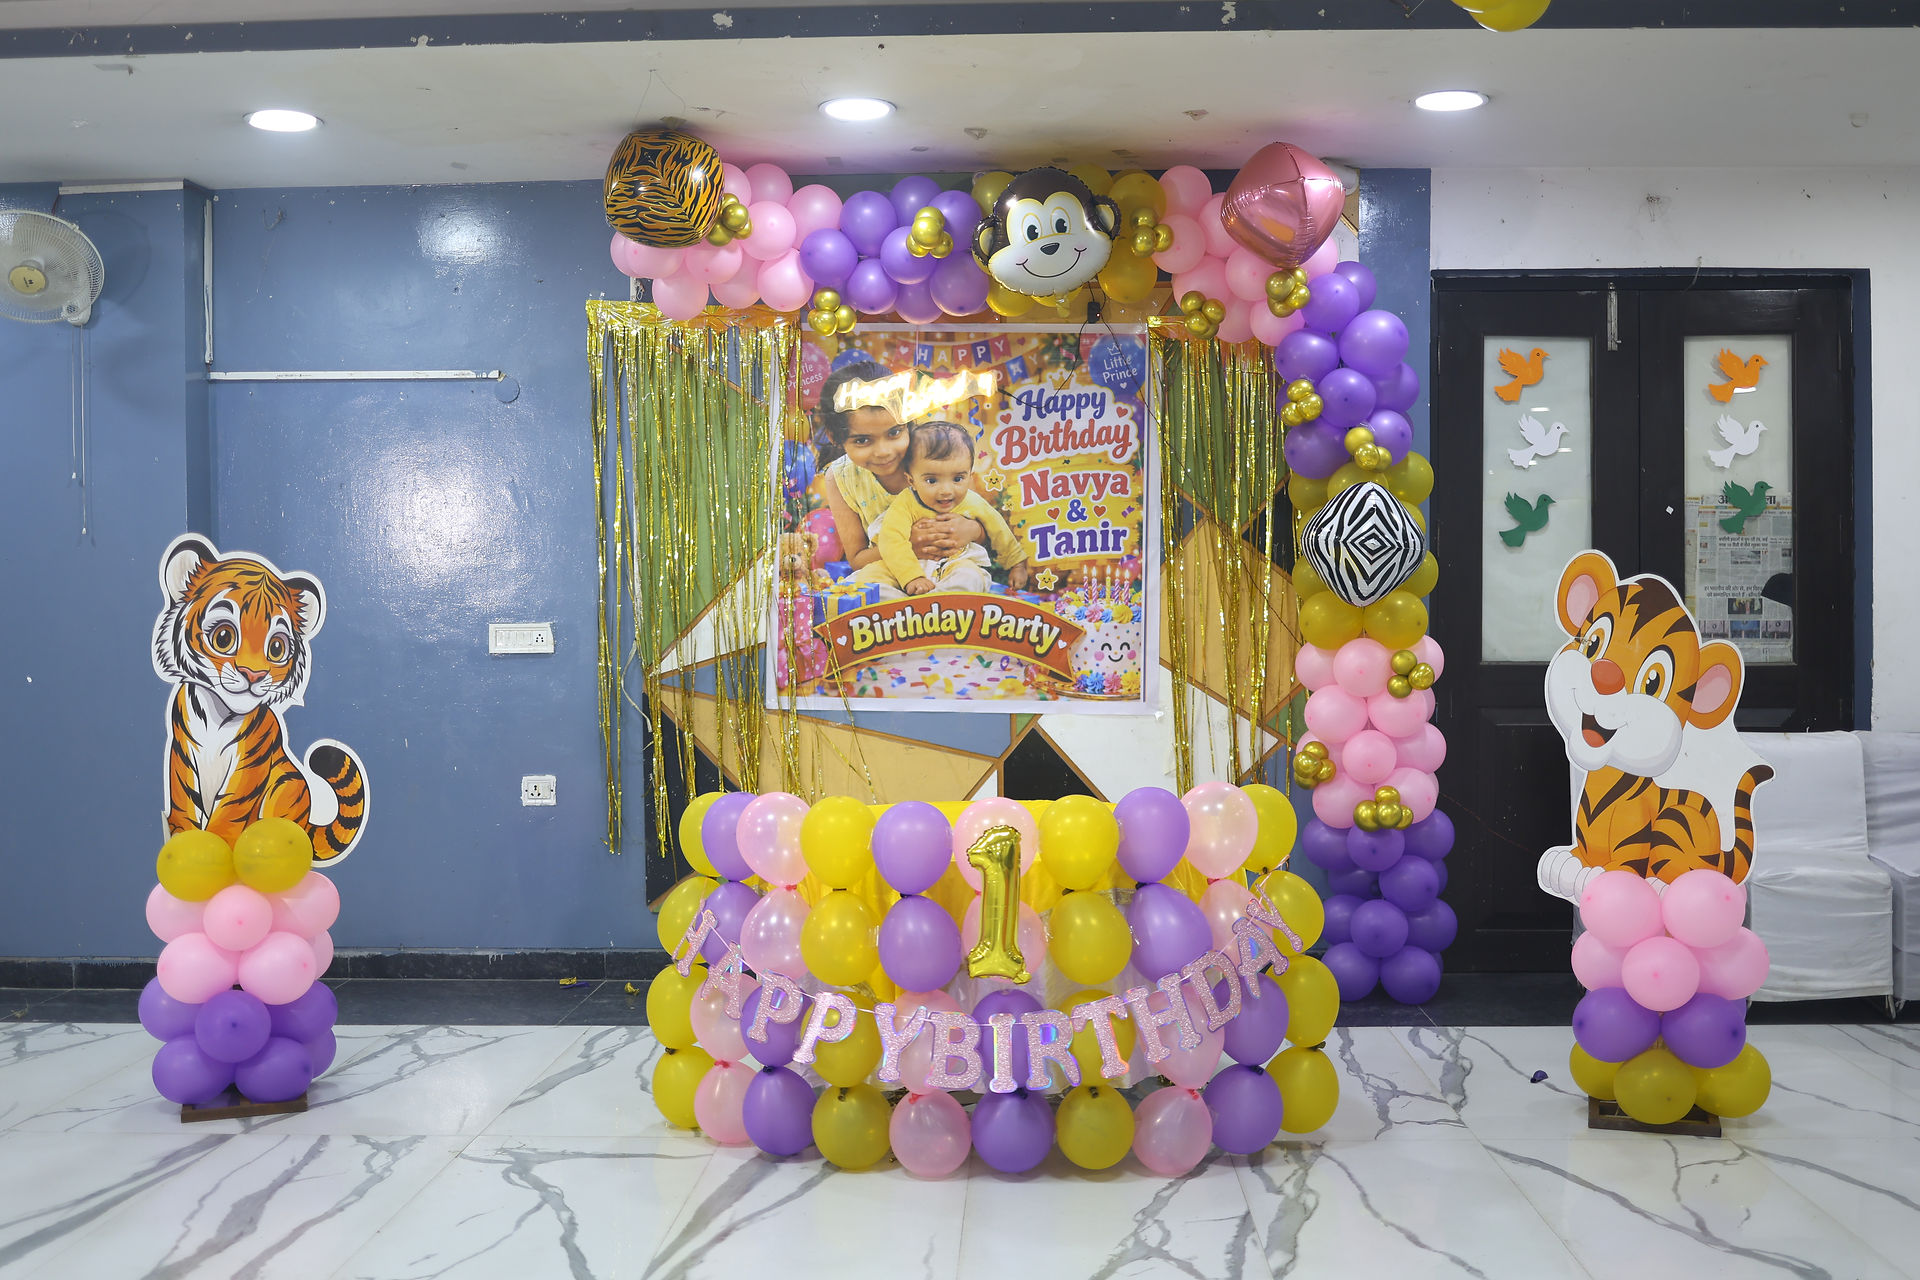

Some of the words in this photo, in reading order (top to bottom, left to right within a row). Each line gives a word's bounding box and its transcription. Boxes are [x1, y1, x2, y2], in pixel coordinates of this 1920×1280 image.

[918, 340, 1005, 362] HAPPY
[1103, 354, 1132, 371] Little
[1102, 367, 1138, 383] Prince
[1016, 388, 1106, 421] Happy
[995, 419, 1133, 466] Birthday
[1020, 470, 1129, 506] Navya
[1067, 499, 1087, 522] &
[1030, 521, 1127, 559] Tanir
[849, 602, 975, 652] Birthday
[979, 604, 1060, 656] Party
[967, 825, 1026, 984] 1
